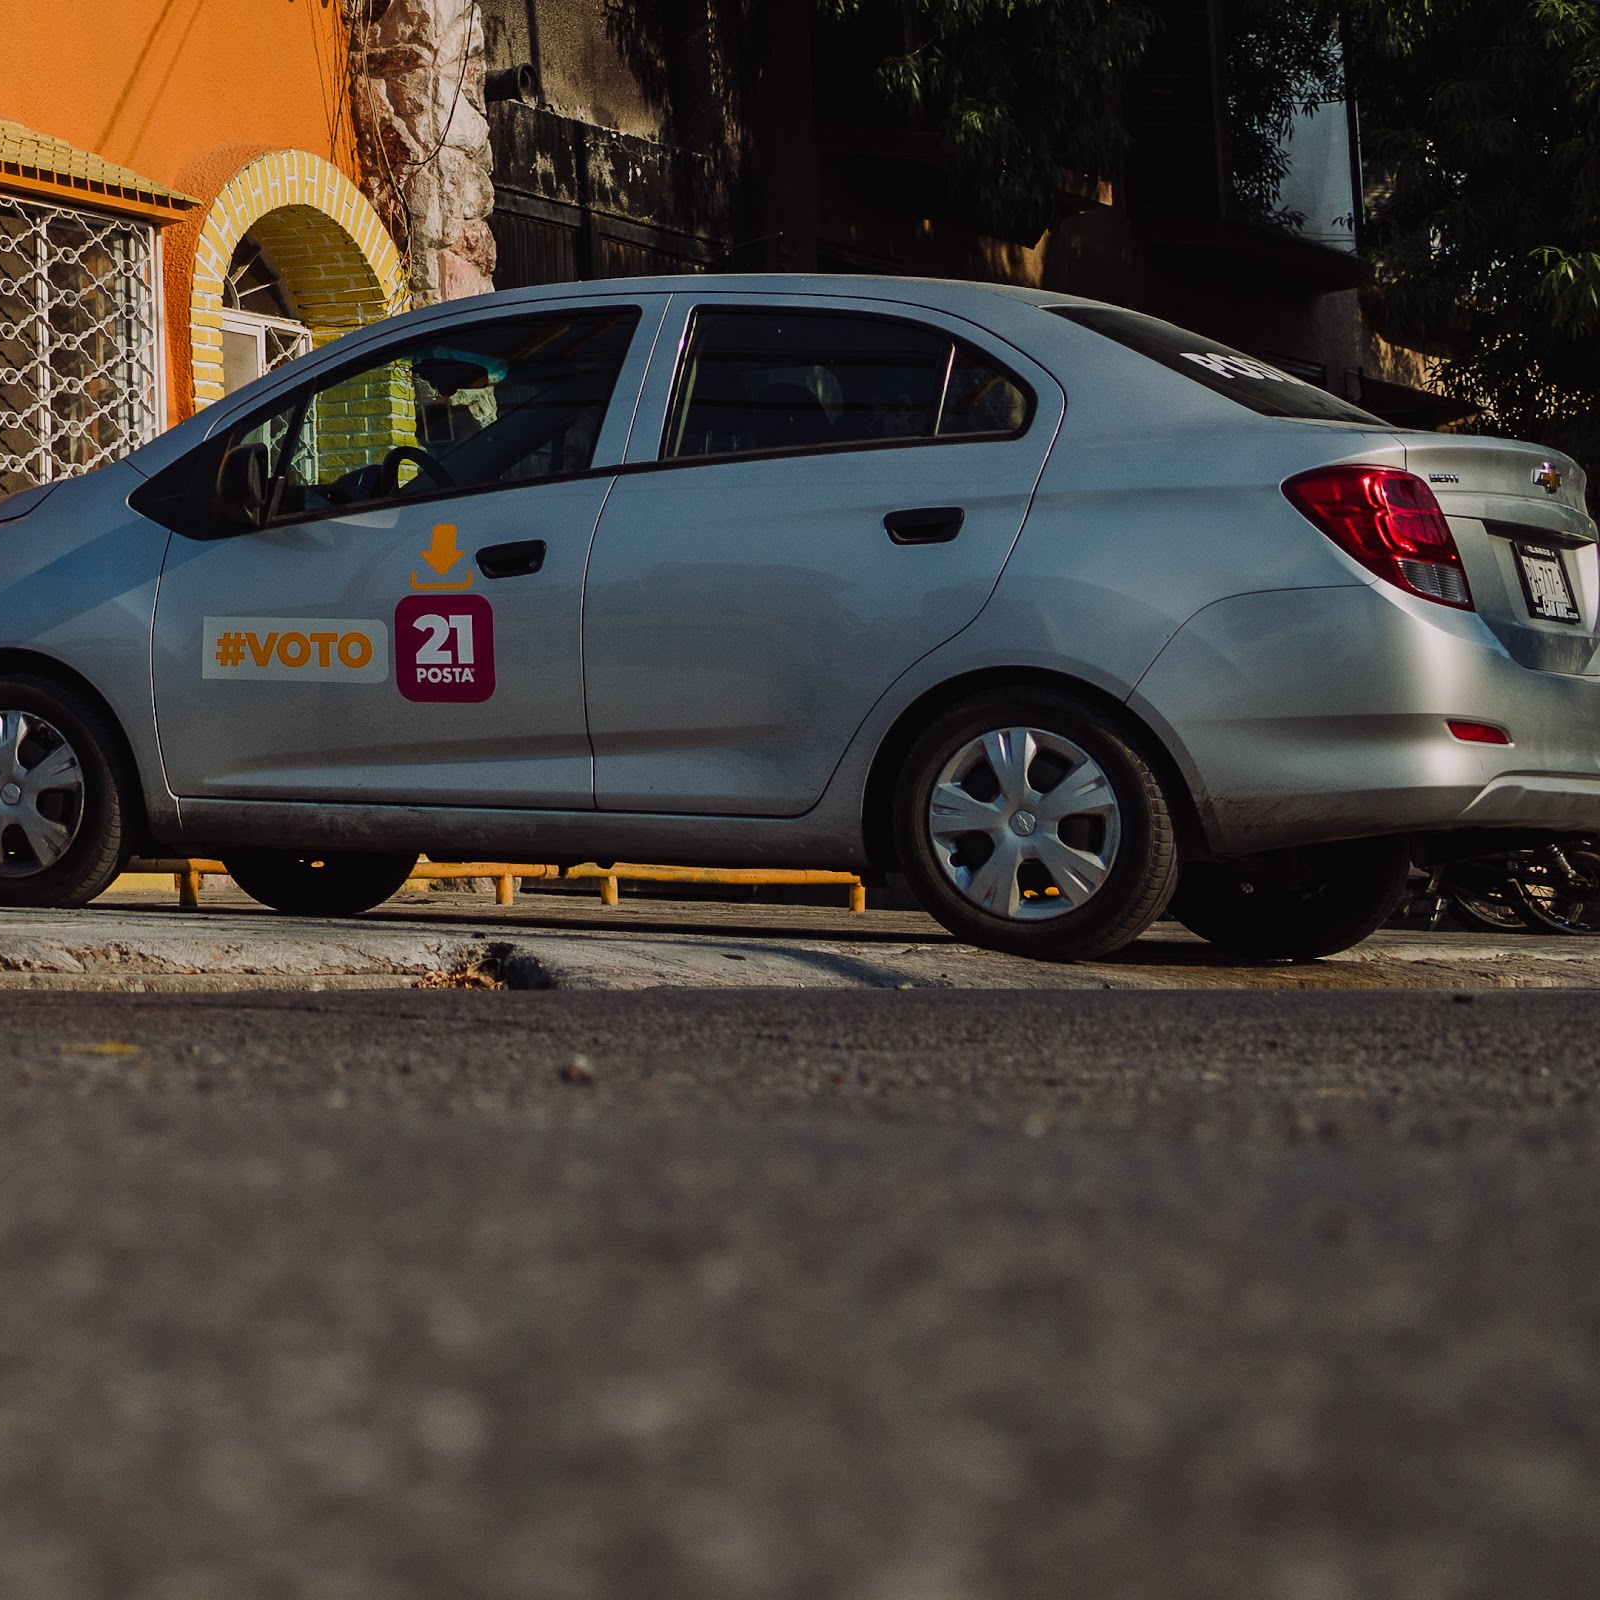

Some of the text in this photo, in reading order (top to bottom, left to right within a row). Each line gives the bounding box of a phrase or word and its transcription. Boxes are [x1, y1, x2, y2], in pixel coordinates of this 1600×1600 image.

[215, 631, 373, 669] #VOTO
[412, 613, 475, 665] 21
[416, 667, 475, 683] POSTA
